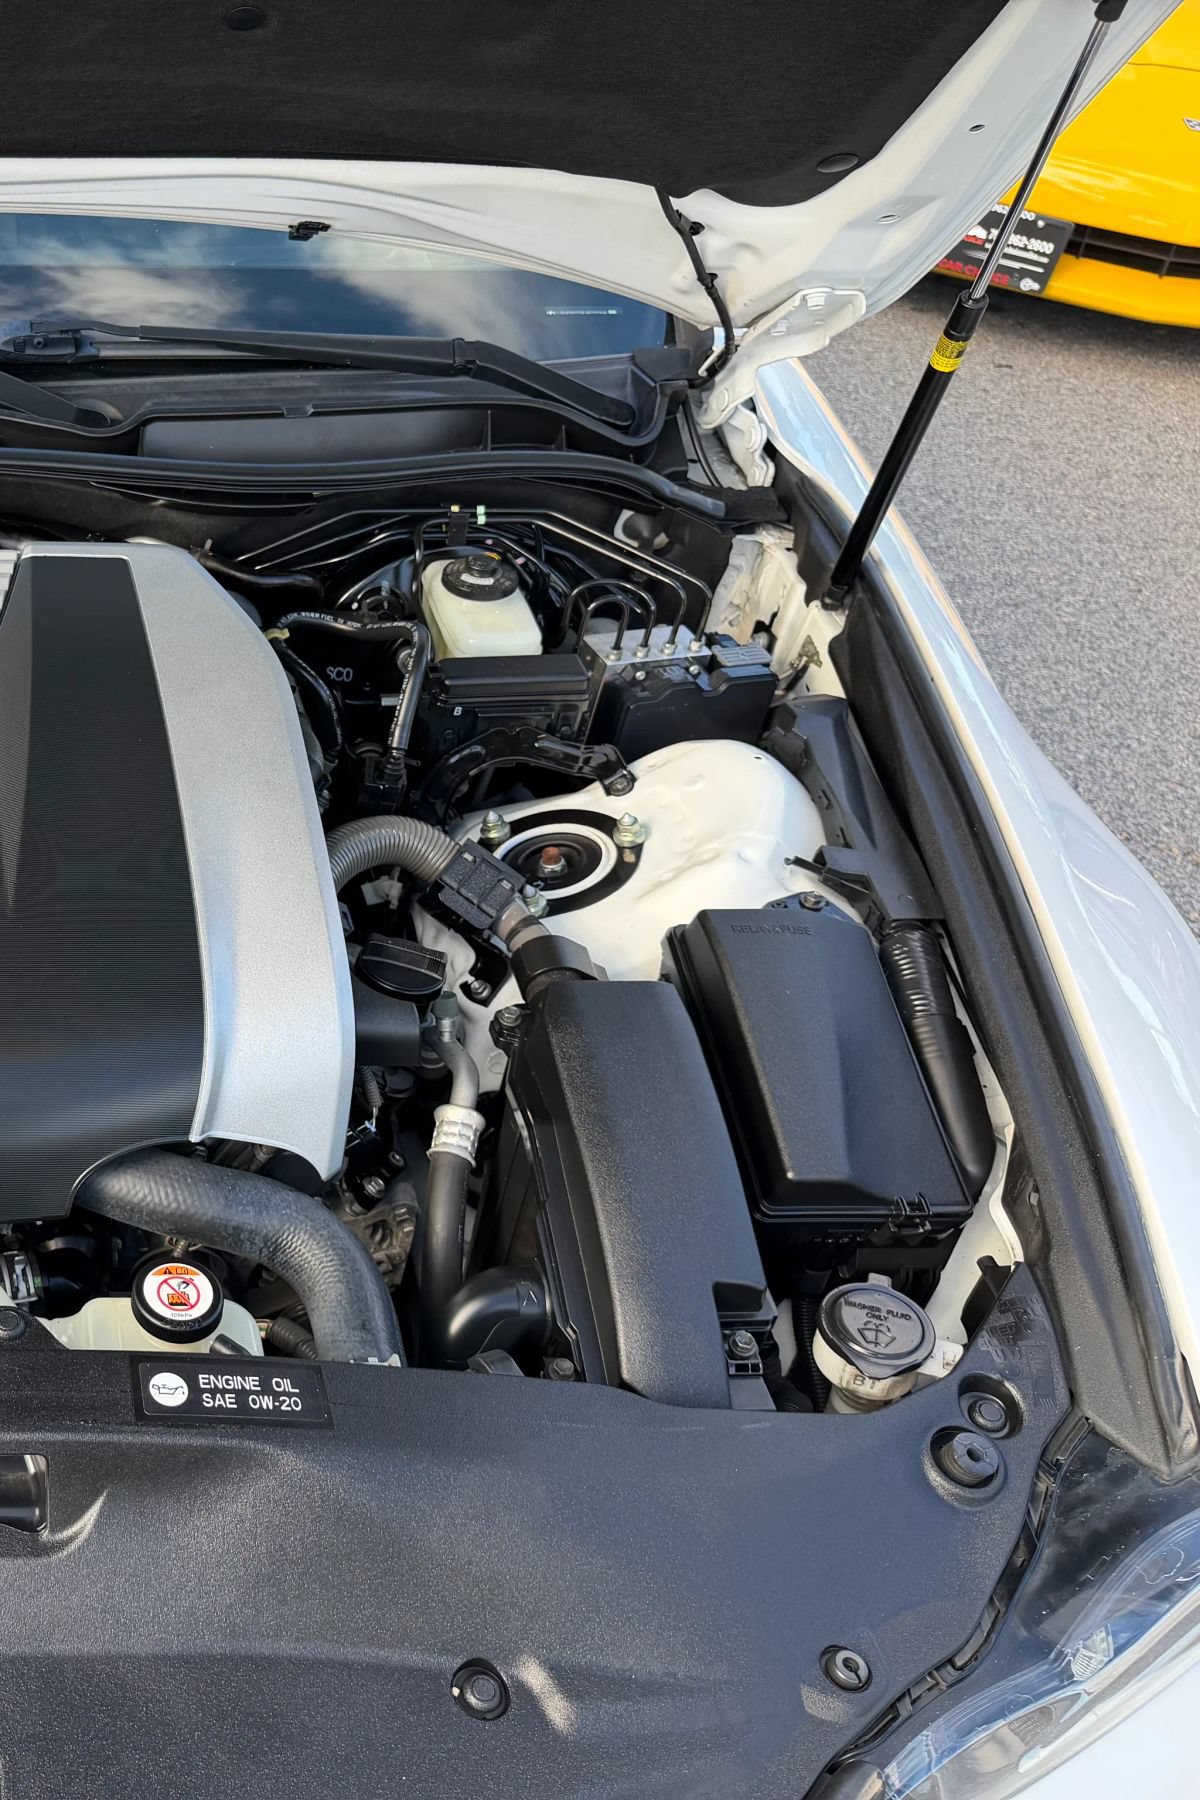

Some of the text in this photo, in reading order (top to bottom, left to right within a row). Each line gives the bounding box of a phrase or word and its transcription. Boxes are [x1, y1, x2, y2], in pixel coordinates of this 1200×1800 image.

[865, 1311, 889, 1322] ONLY
[886, 1308, 912, 1321] FLUID
[198, 1374, 300, 1393] ENGINE OIL
[202, 1392, 302, 1412] SAE 0W-20
